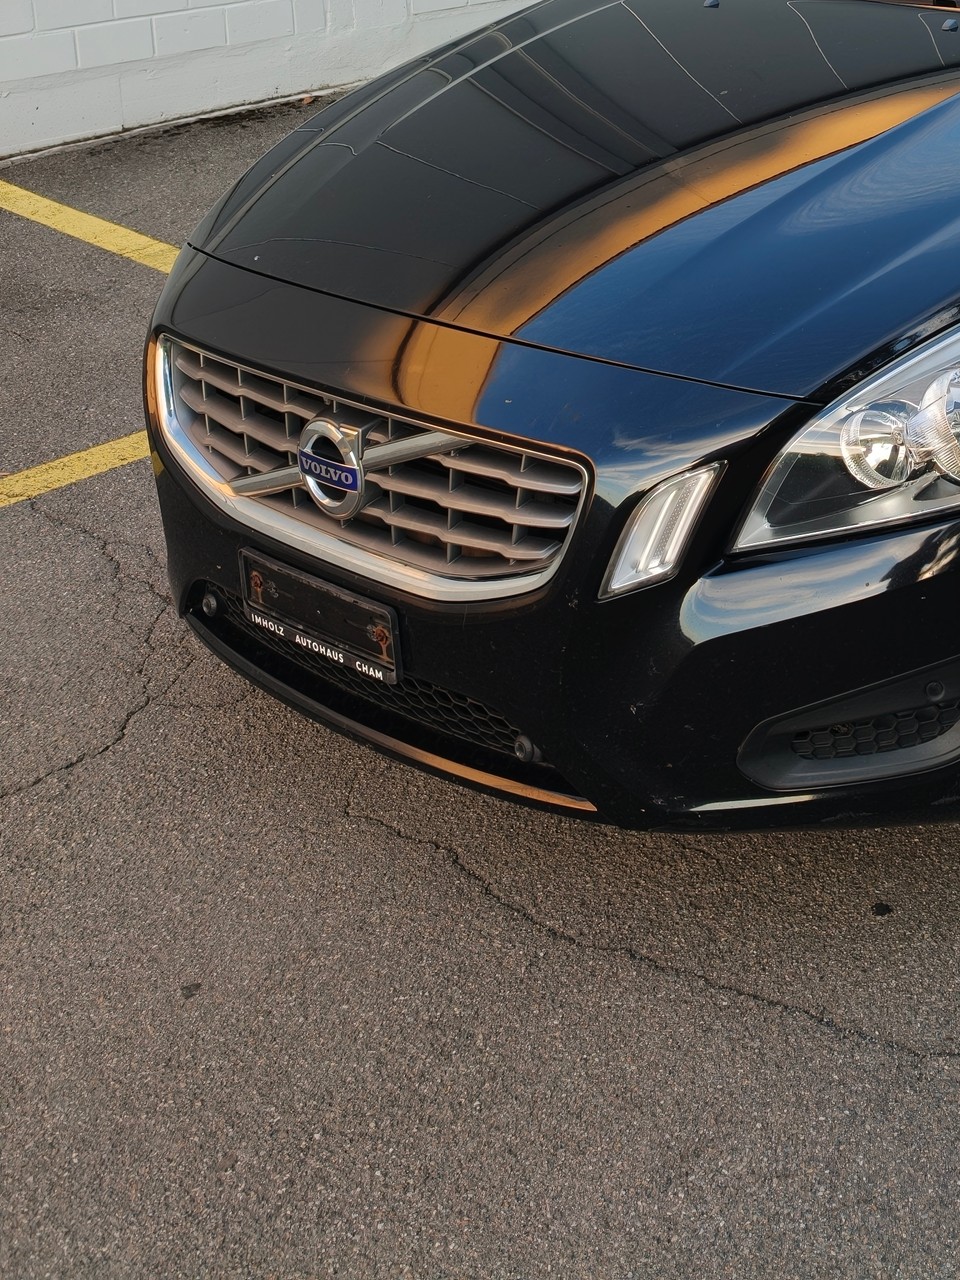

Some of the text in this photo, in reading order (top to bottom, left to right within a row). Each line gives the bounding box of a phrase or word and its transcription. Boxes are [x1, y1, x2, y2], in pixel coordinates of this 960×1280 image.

[300, 456, 353, 485] VOLVO
[251, 613, 383, 681] IMHOLZ AUTOHAUS CHAM
